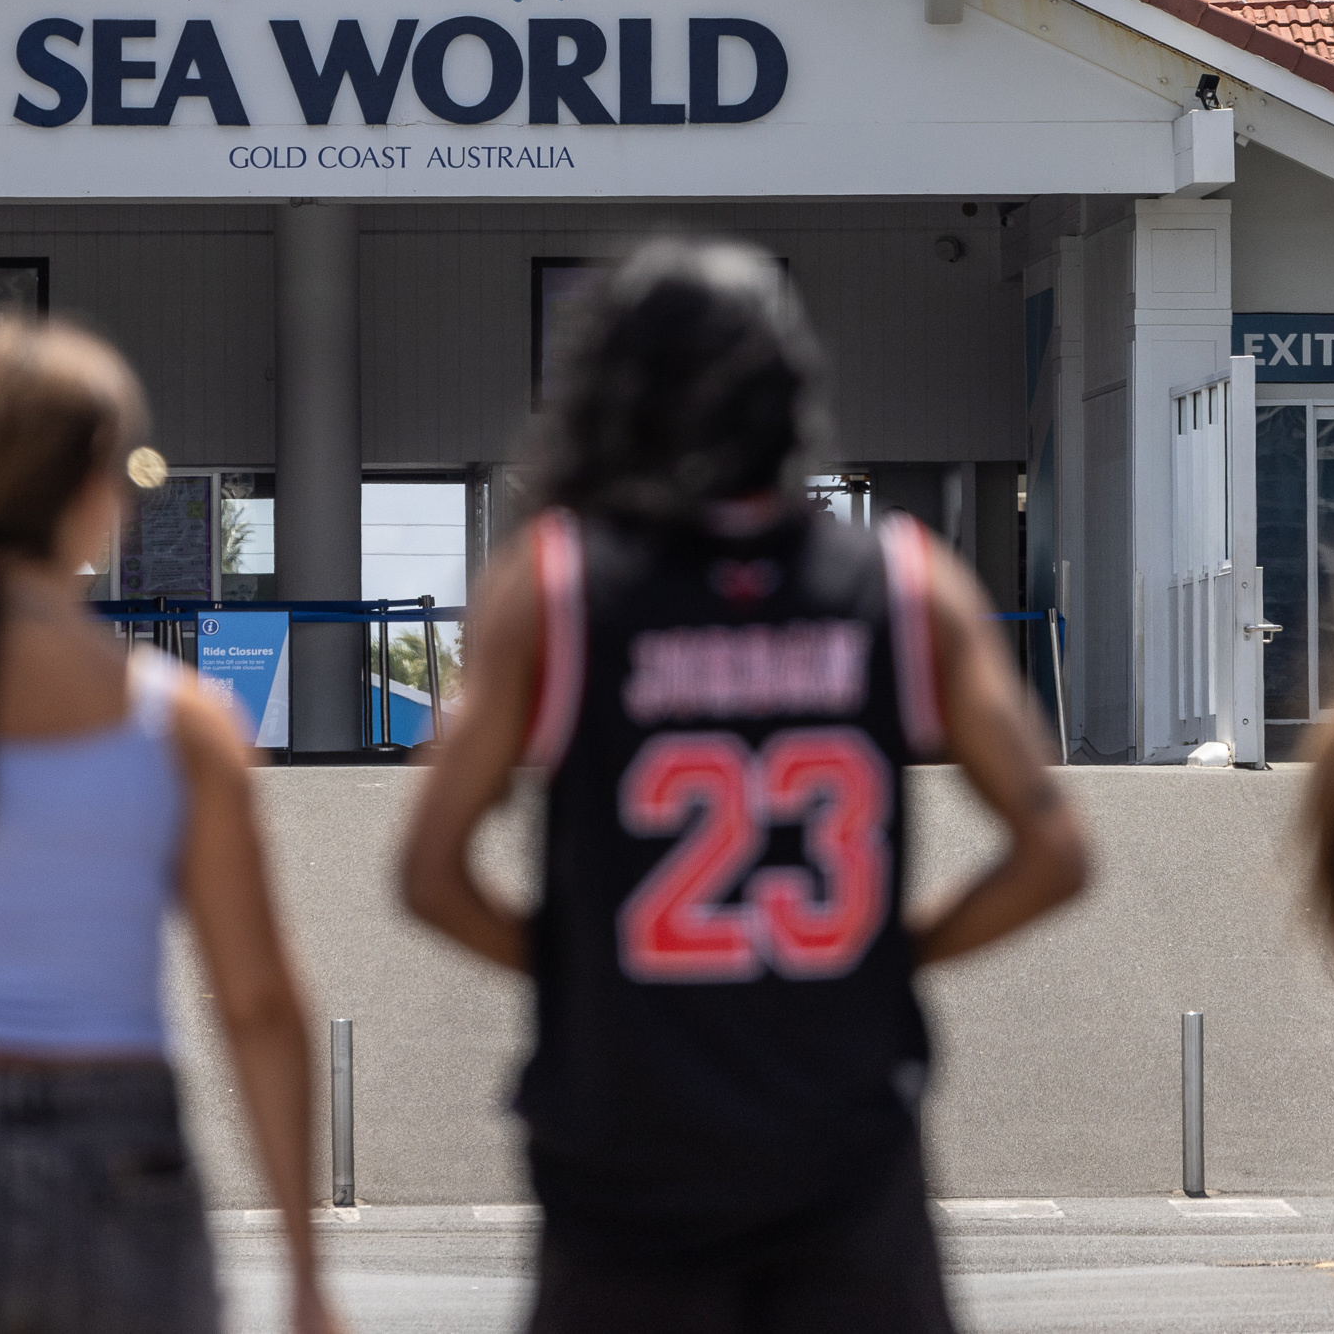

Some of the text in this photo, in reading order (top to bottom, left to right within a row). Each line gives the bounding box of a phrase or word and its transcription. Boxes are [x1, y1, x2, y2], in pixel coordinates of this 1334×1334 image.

[13, 16, 788, 127] SEA WORLD
[229, 145, 575, 169] GOLD COAST AUSTRALIA
[203, 647, 274, 656] Ride Closures
[618, 729, 894, 983] 23
